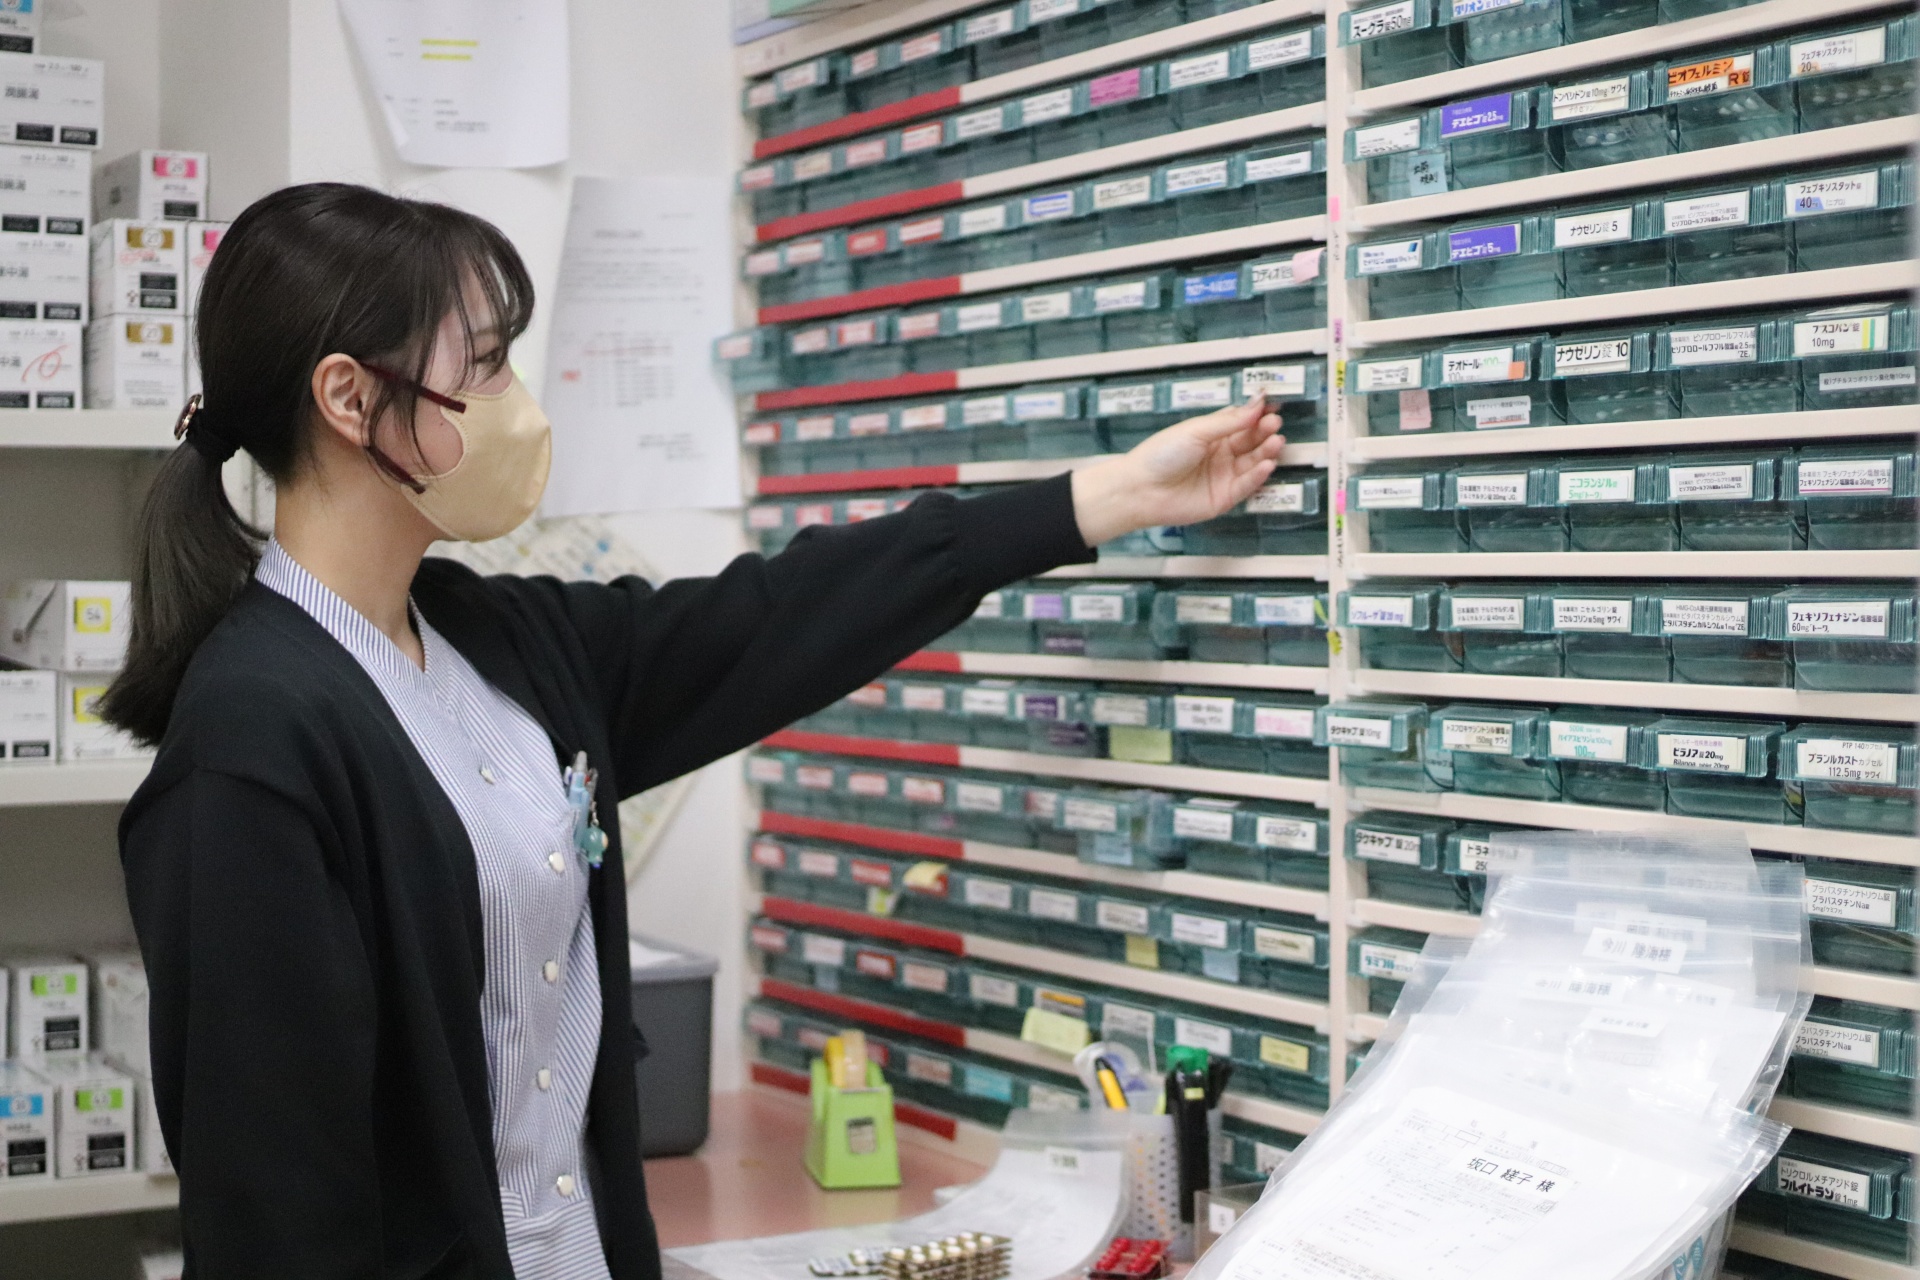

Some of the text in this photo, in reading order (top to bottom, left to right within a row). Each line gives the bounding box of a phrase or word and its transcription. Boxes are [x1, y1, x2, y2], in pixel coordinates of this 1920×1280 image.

[1668, 59, 1733, 84] ビオフェルミン
[1570, 220, 1619, 237] ナウゼリン錠 5
[1811, 337, 1836, 348] 10mg
[1556, 342, 1629, 363] ナウゼリン錠 10
[1580, 605, 1618, 614] ニセルゴリン錠
[1792, 612, 1884, 624] フェキソフェナジン塩酸塩錠
[1828, 766, 1881, 780] 112.5mg サワイ
[1812, 884, 1891, 902] プラバスタチンナトリウム錠
[1467, 1157, 1498, 1176] 坂口
[1535, 1179, 1556, 1194] 様
[1780, 1167, 1859, 1193] トリクロルメチアジド錠
[1780, 1178, 1858, 1208] フルイトラン錠 1mg
